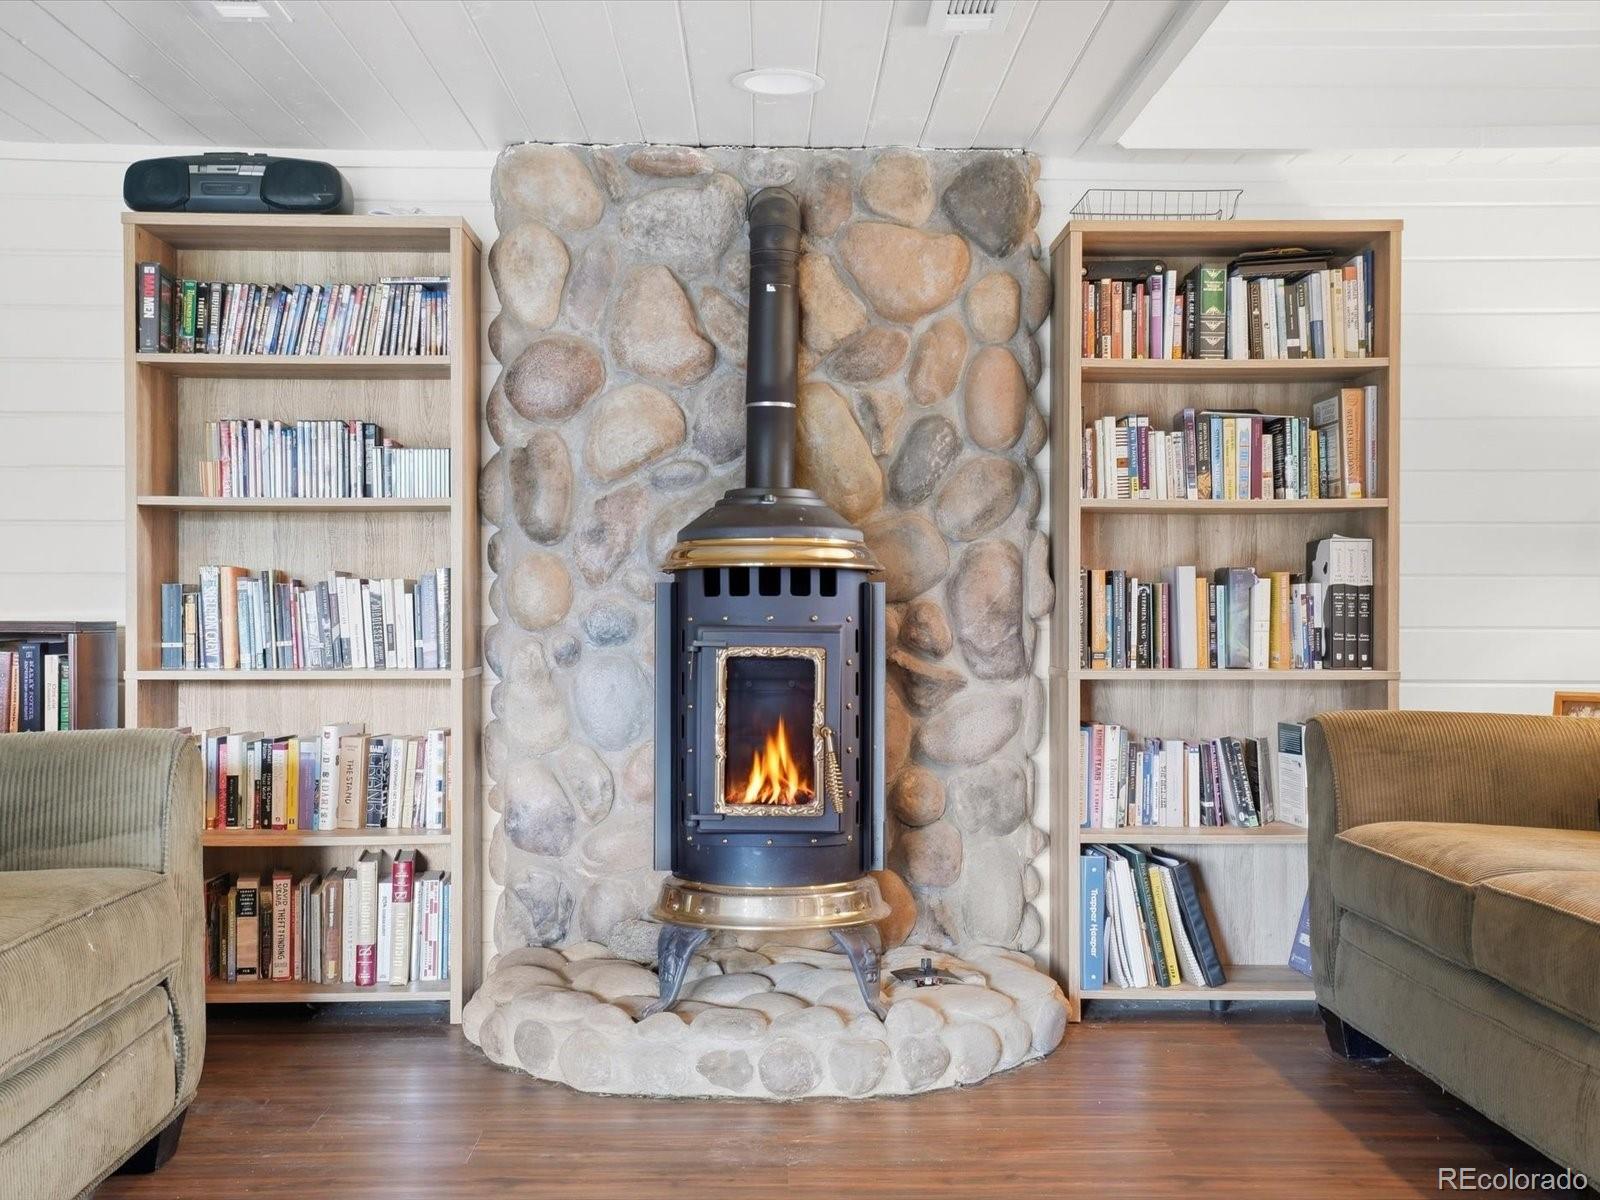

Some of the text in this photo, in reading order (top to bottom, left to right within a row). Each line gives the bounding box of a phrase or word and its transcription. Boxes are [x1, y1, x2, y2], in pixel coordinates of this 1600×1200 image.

[144, 297, 154, 318] MEN
[1346, 409, 1354, 434] WORLD
[206, 631, 219, 656] CREW
[345, 760, 354, 804] THE STAND
[367, 754, 384, 813] CRANK
[1089, 888, 1098, 922] Trapper
[277, 935, 285, 960] FINDING
